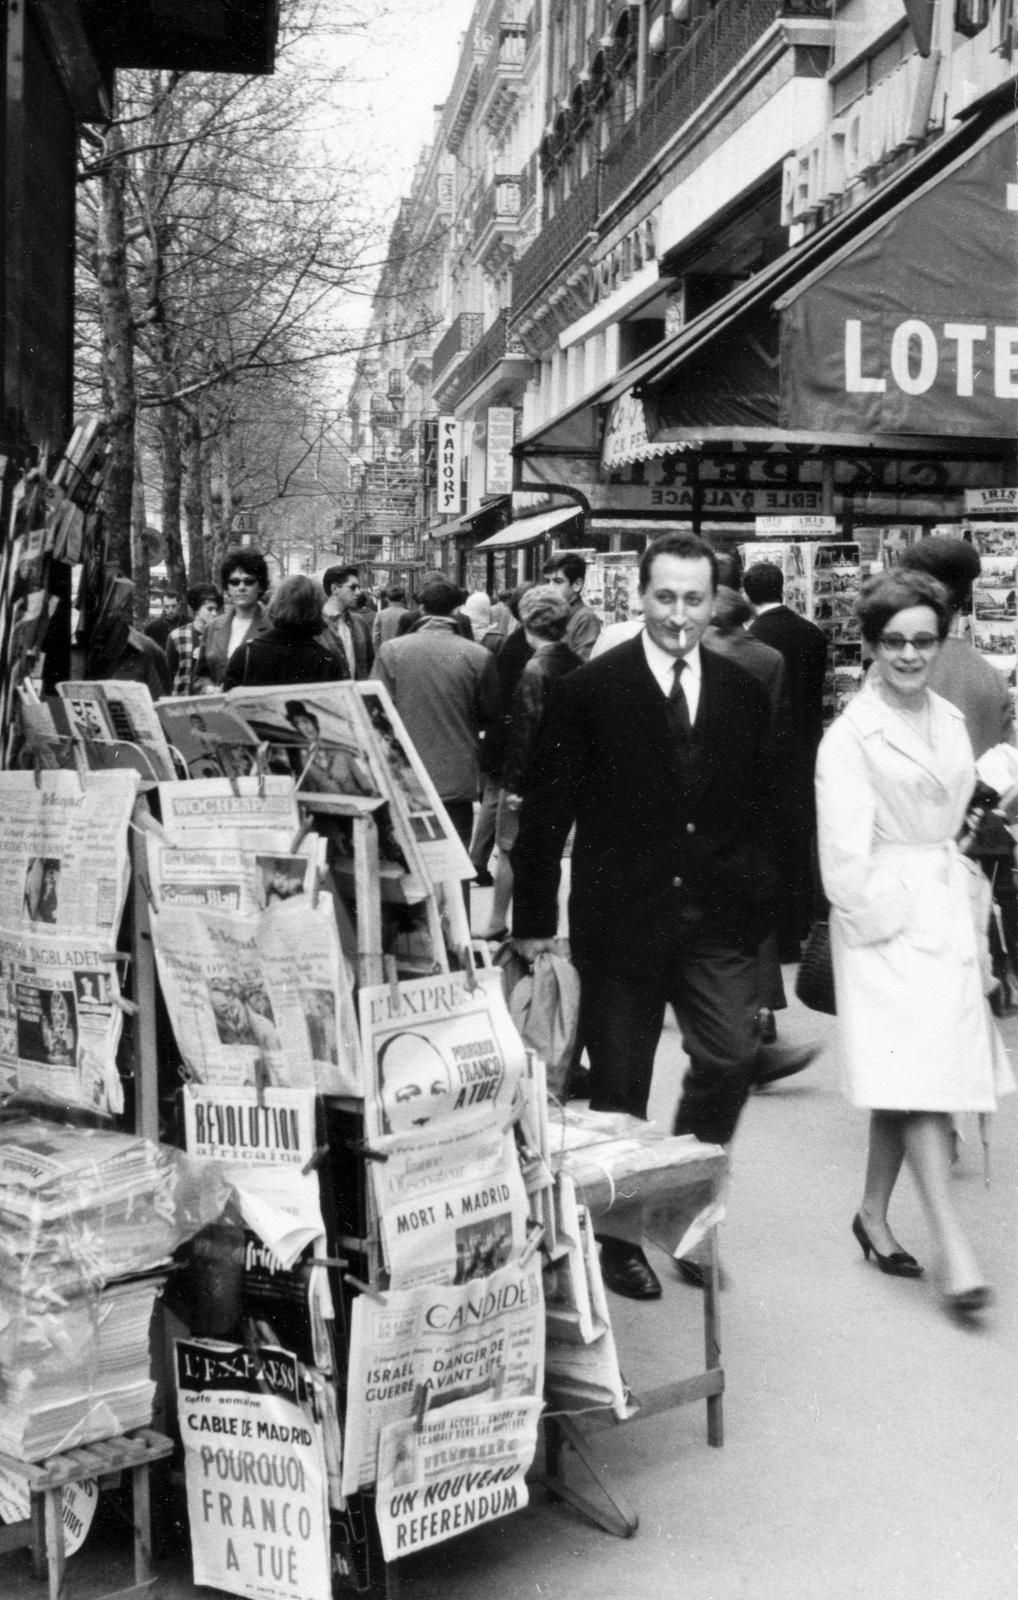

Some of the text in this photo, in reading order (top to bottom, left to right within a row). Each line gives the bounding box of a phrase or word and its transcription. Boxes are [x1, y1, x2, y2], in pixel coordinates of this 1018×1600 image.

[845, 319, 1018, 398] LOTE
[443, 422, 456, 507] CAHORS
[981, 490, 1017, 500] IRIS
[371, 982, 487, 1024] L'EXPRE
[458, 1056, 500, 1084] FRANCO
[453, 1087, 466, 1110] A
[397, 1184, 510, 1234] MORT A MADRID
[425, 1279, 528, 1329] CANDIDE
[367, 1362, 414, 1384] ISRAEL
[433, 1347, 487, 1373] DANGER
[490, 1339, 505, 1354] DE
[365, 1378, 414, 1402] GUERRE
[423, 1368, 474, 1390] AVANT
[188, 1414, 312, 1446] CABLE DE MADRID
[201, 1445, 305, 1493] POURQUOI
[390, 1464, 520, 1518] UN NOUVEAU
[202, 1489, 311, 1540] FRANCO
[397, 1485, 518, 1549] REFERENDUM
[227, 1538, 240, 1571] A
